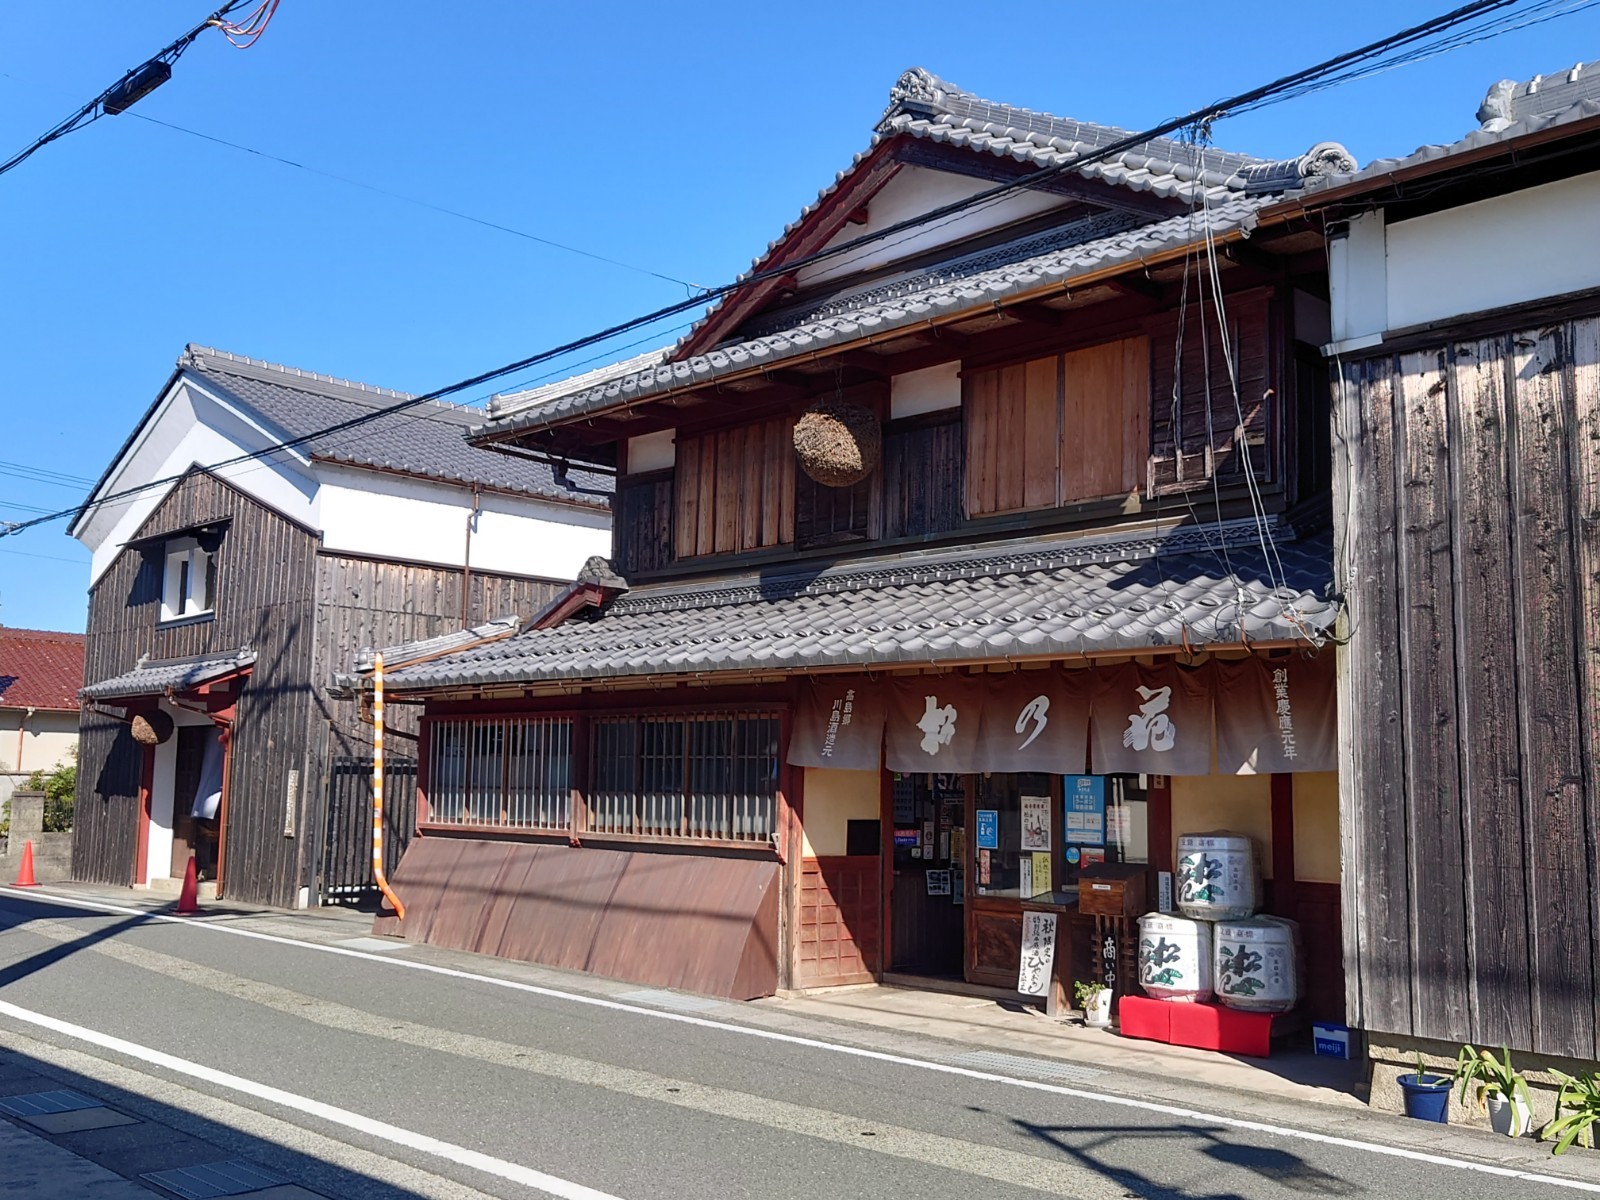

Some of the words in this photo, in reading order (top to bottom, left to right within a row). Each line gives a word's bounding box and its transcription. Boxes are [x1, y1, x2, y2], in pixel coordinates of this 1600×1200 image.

[1103, 937, 1116, 989] 商い中
[1318, 1043, 1341, 1053] meiji
